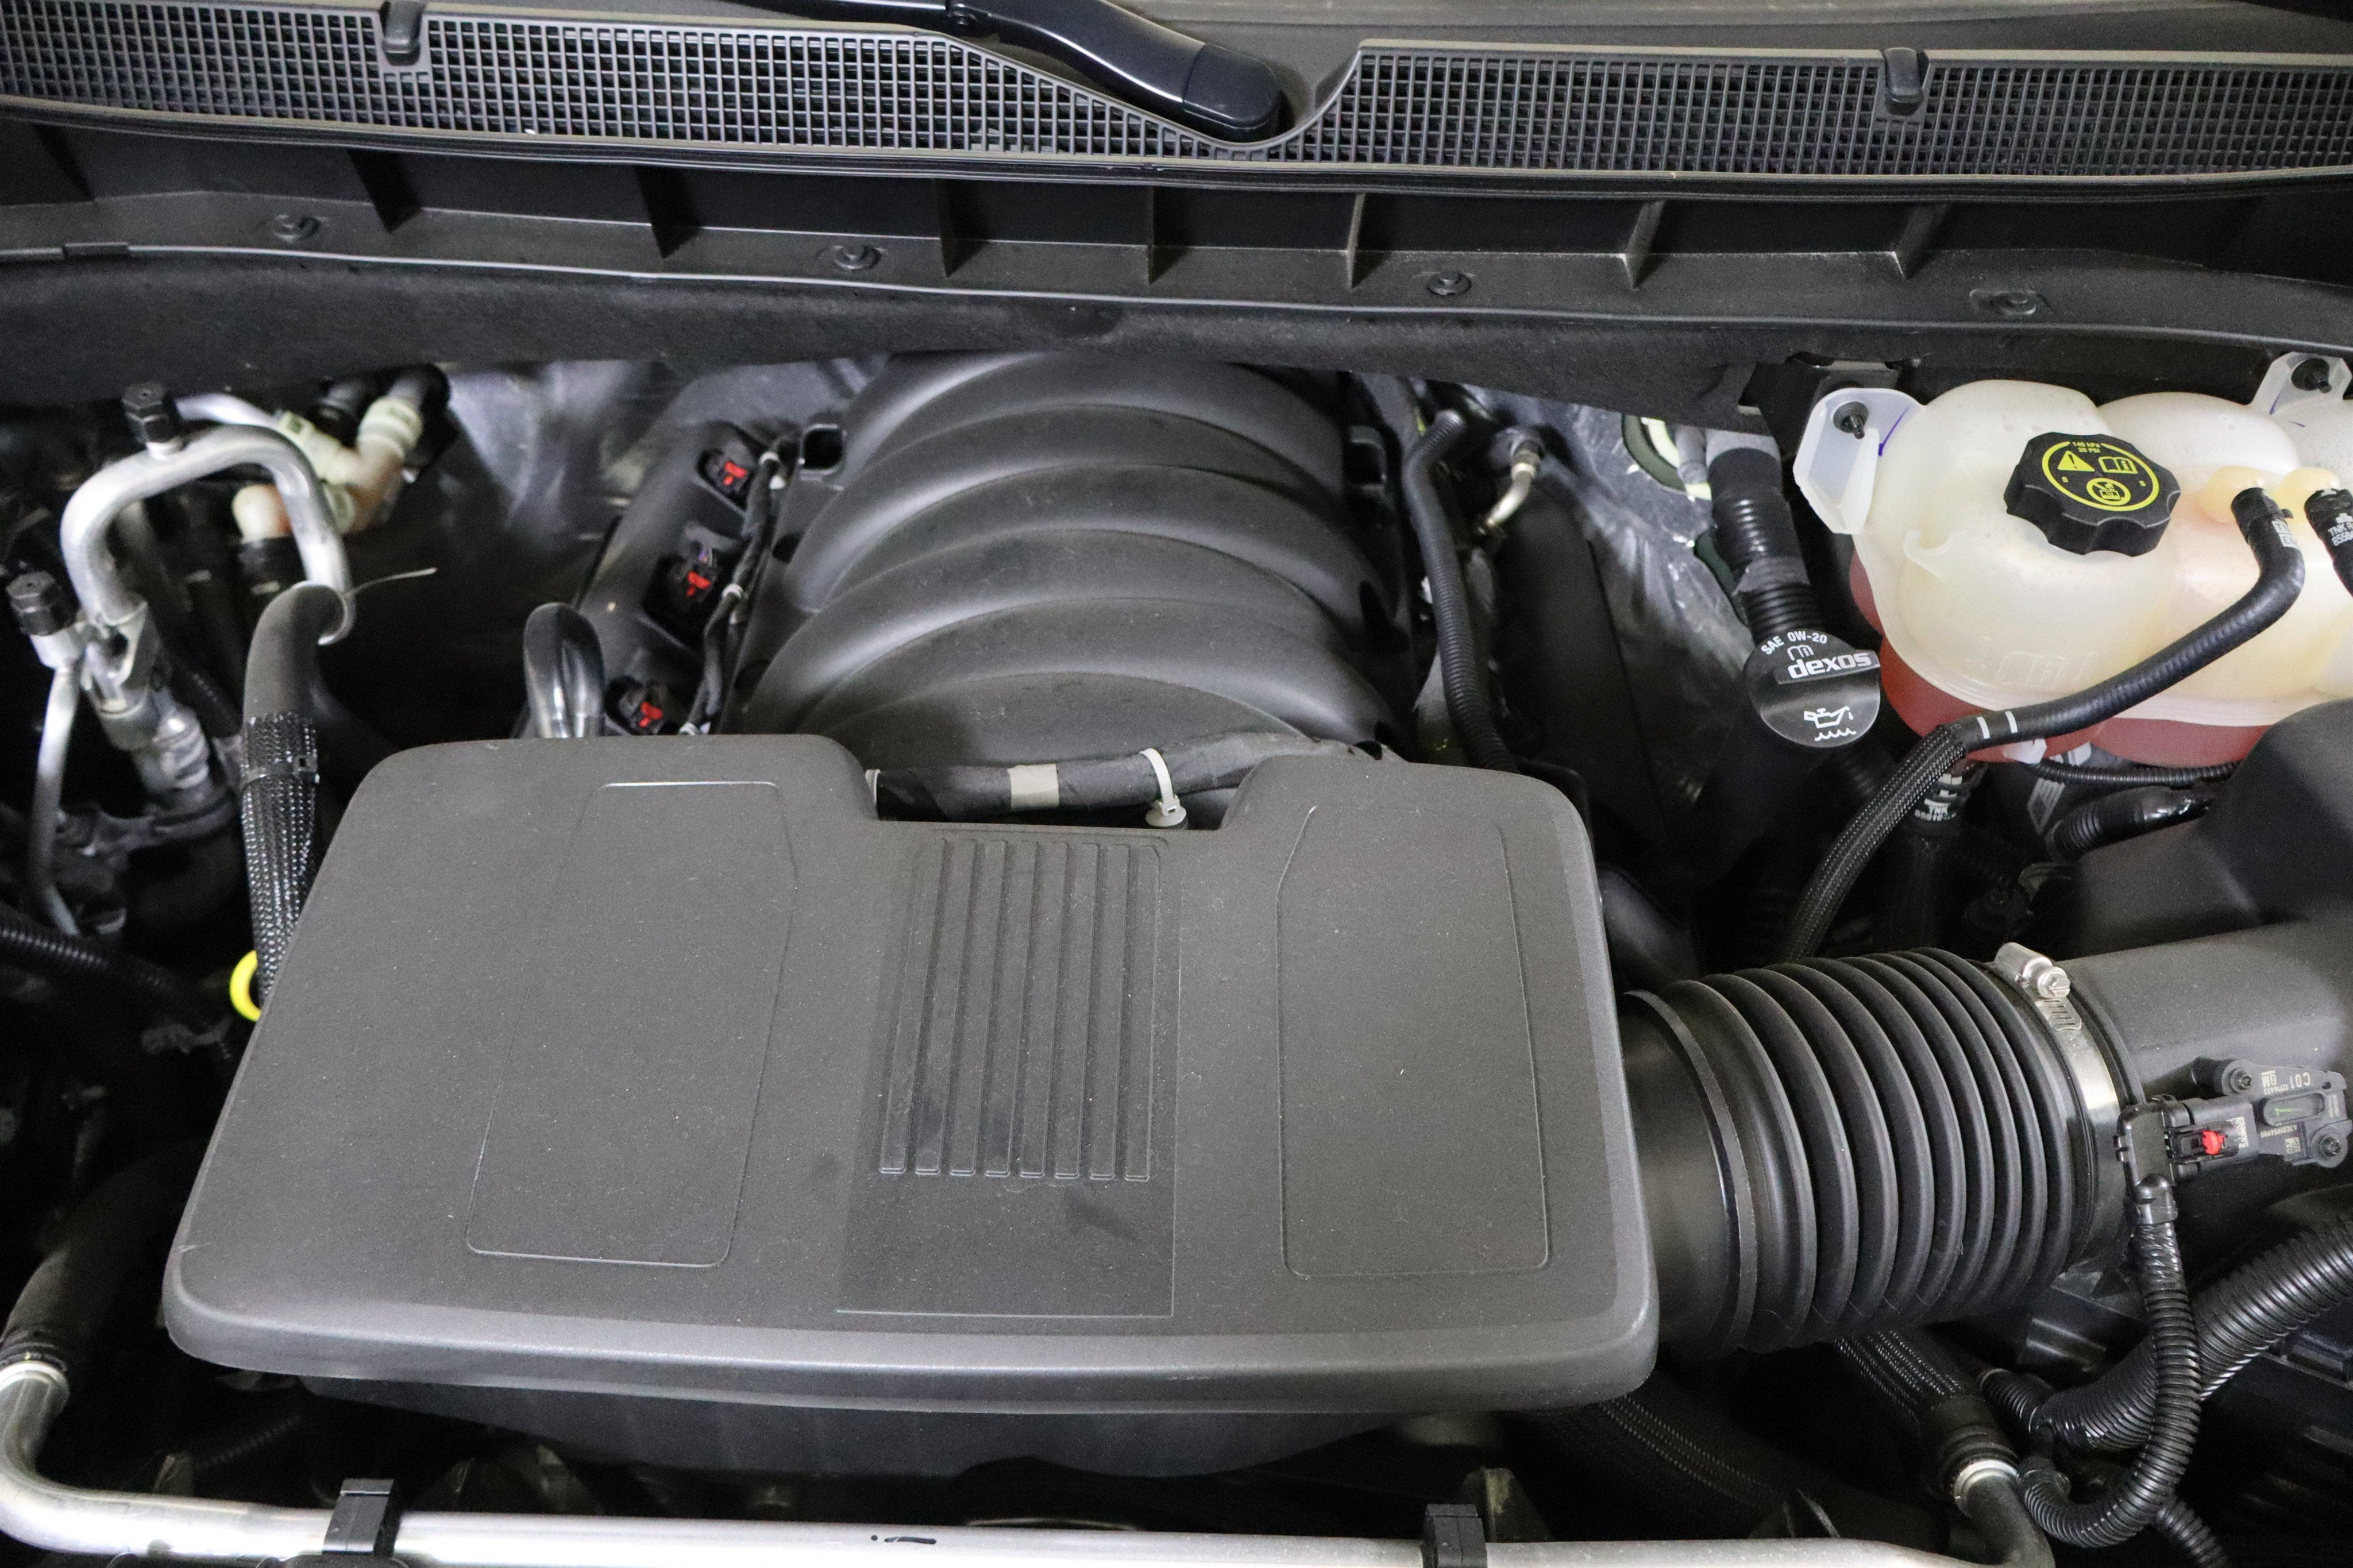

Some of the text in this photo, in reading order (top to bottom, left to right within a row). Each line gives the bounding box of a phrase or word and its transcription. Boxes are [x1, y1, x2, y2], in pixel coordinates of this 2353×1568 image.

[1761, 631, 1828, 655] SAE 0W-20
[1788, 652, 1872, 679] dexos
[2262, 1073, 2277, 1088] GM
